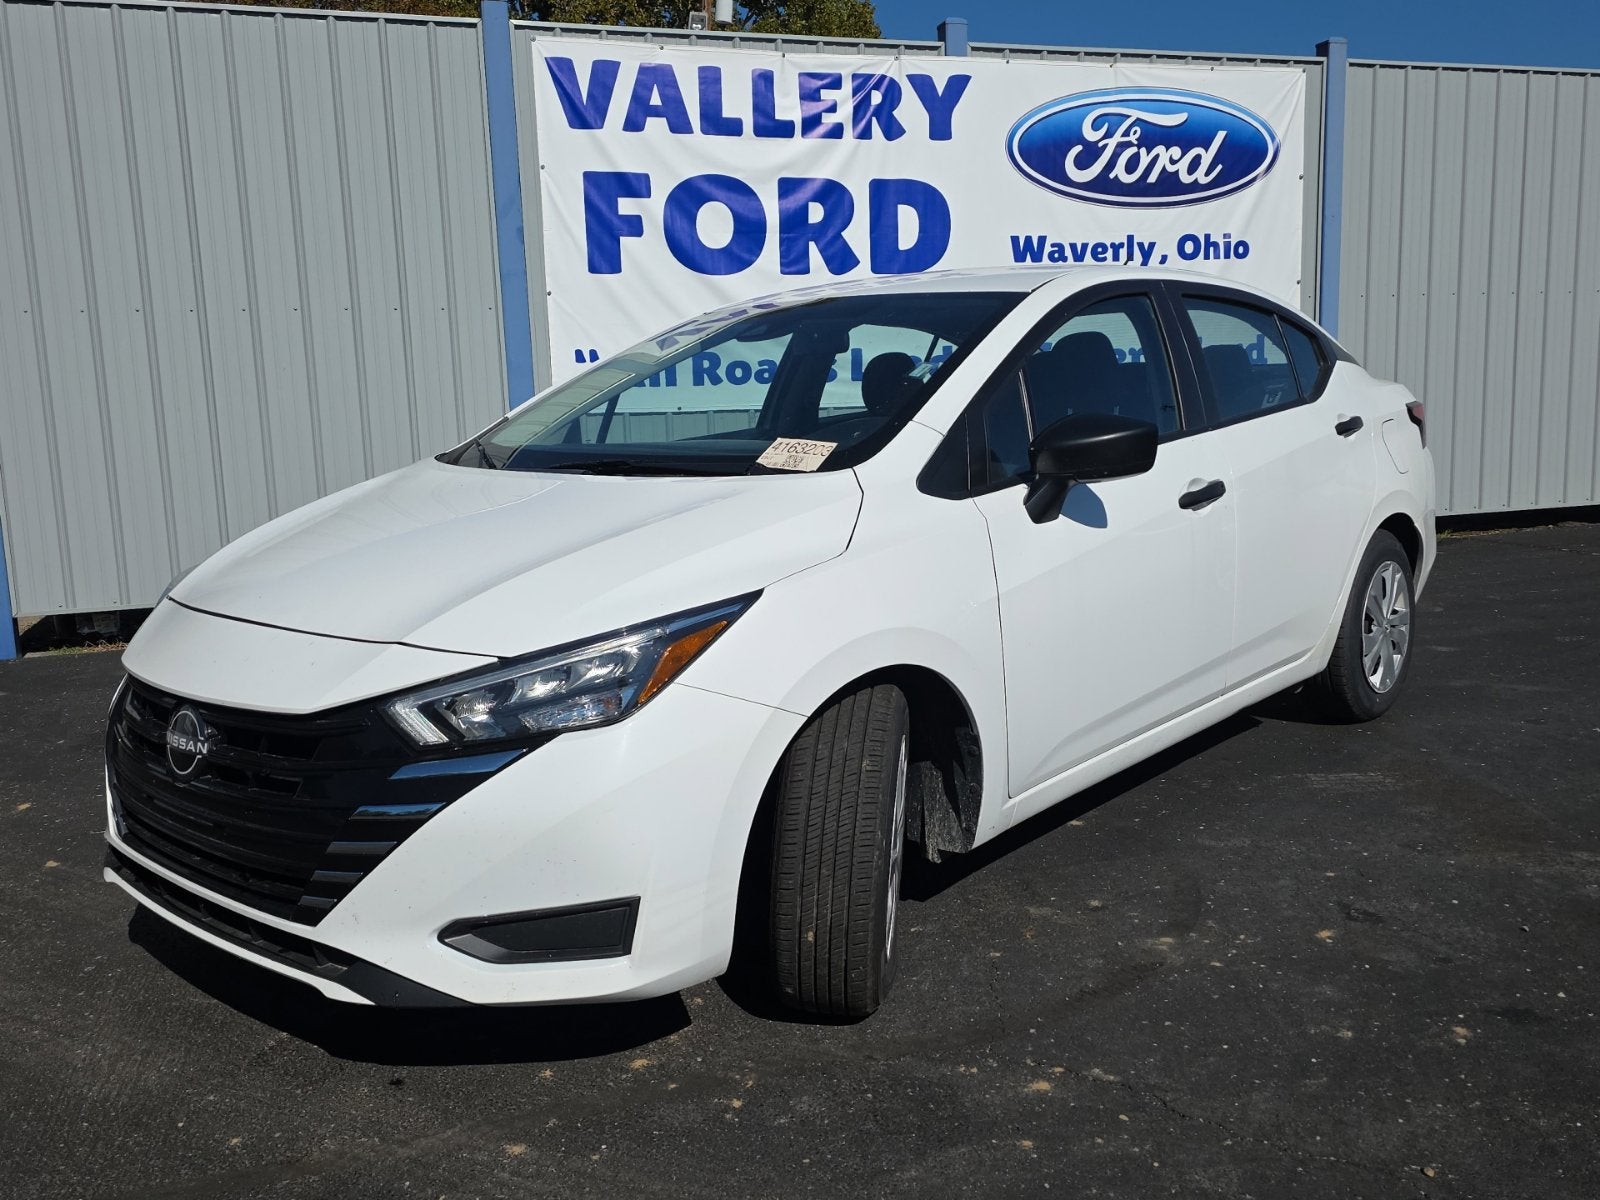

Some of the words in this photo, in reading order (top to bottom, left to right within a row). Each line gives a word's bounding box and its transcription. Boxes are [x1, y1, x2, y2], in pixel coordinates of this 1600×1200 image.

[544, 56, 972, 142] VALLERY
[1064, 106, 1227, 184] Ford
[583, 171, 951, 276] FORD
[1010, 235, 1168, 266] Waverly,
[1176, 233, 1250, 260] Ohio
[771, 441, 833, 457] 4163203
[166, 731, 208, 754] NISSAN
